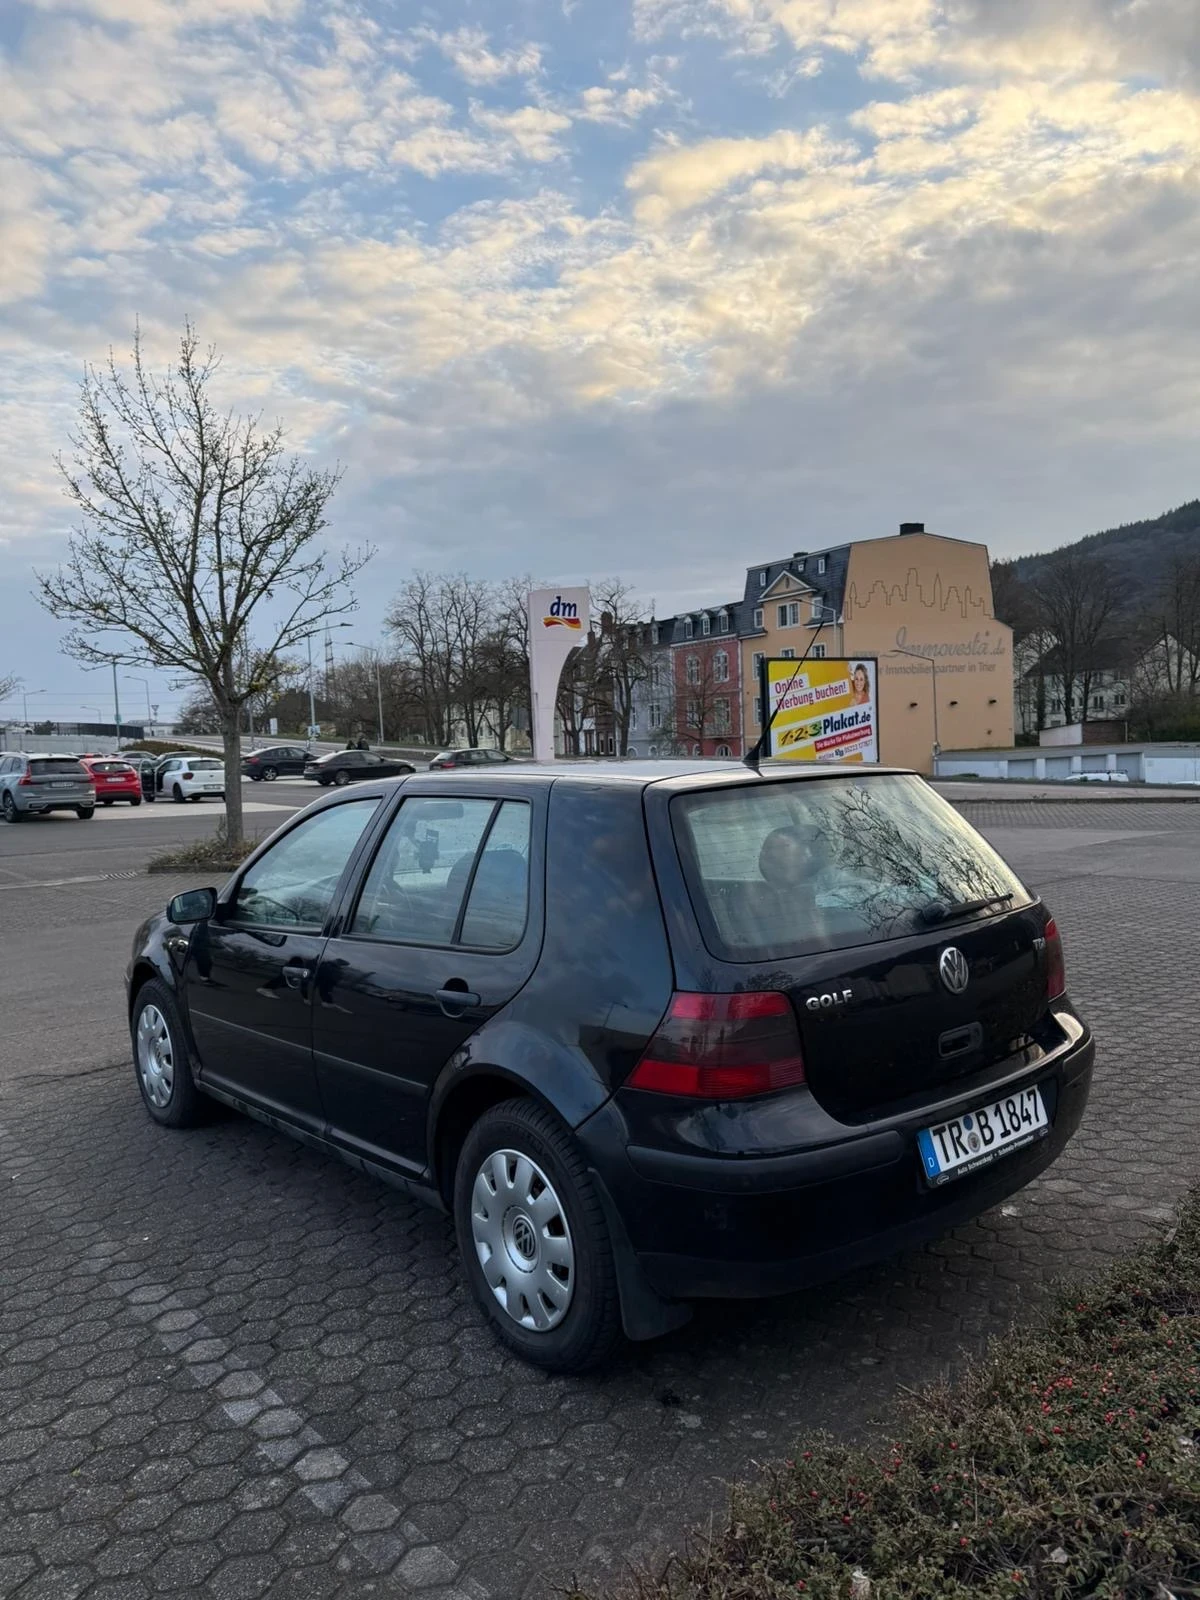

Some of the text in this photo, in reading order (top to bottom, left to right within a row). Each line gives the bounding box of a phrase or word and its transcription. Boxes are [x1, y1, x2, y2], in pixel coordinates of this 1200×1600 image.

[550, 596, 577, 617] dm
[968, 662, 976, 672] in
[978, 661, 997, 672] Trier
[775, 678, 804, 694] Online
[776, 682, 846, 710] Werbung buchen!
[806, 989, 852, 1010] GOLF
[932, 1120, 969, 1163] TR
[975, 1110, 994, 1146] B
[994, 1088, 1040, 1139] 1847
[928, 1157, 935, 1168] D
